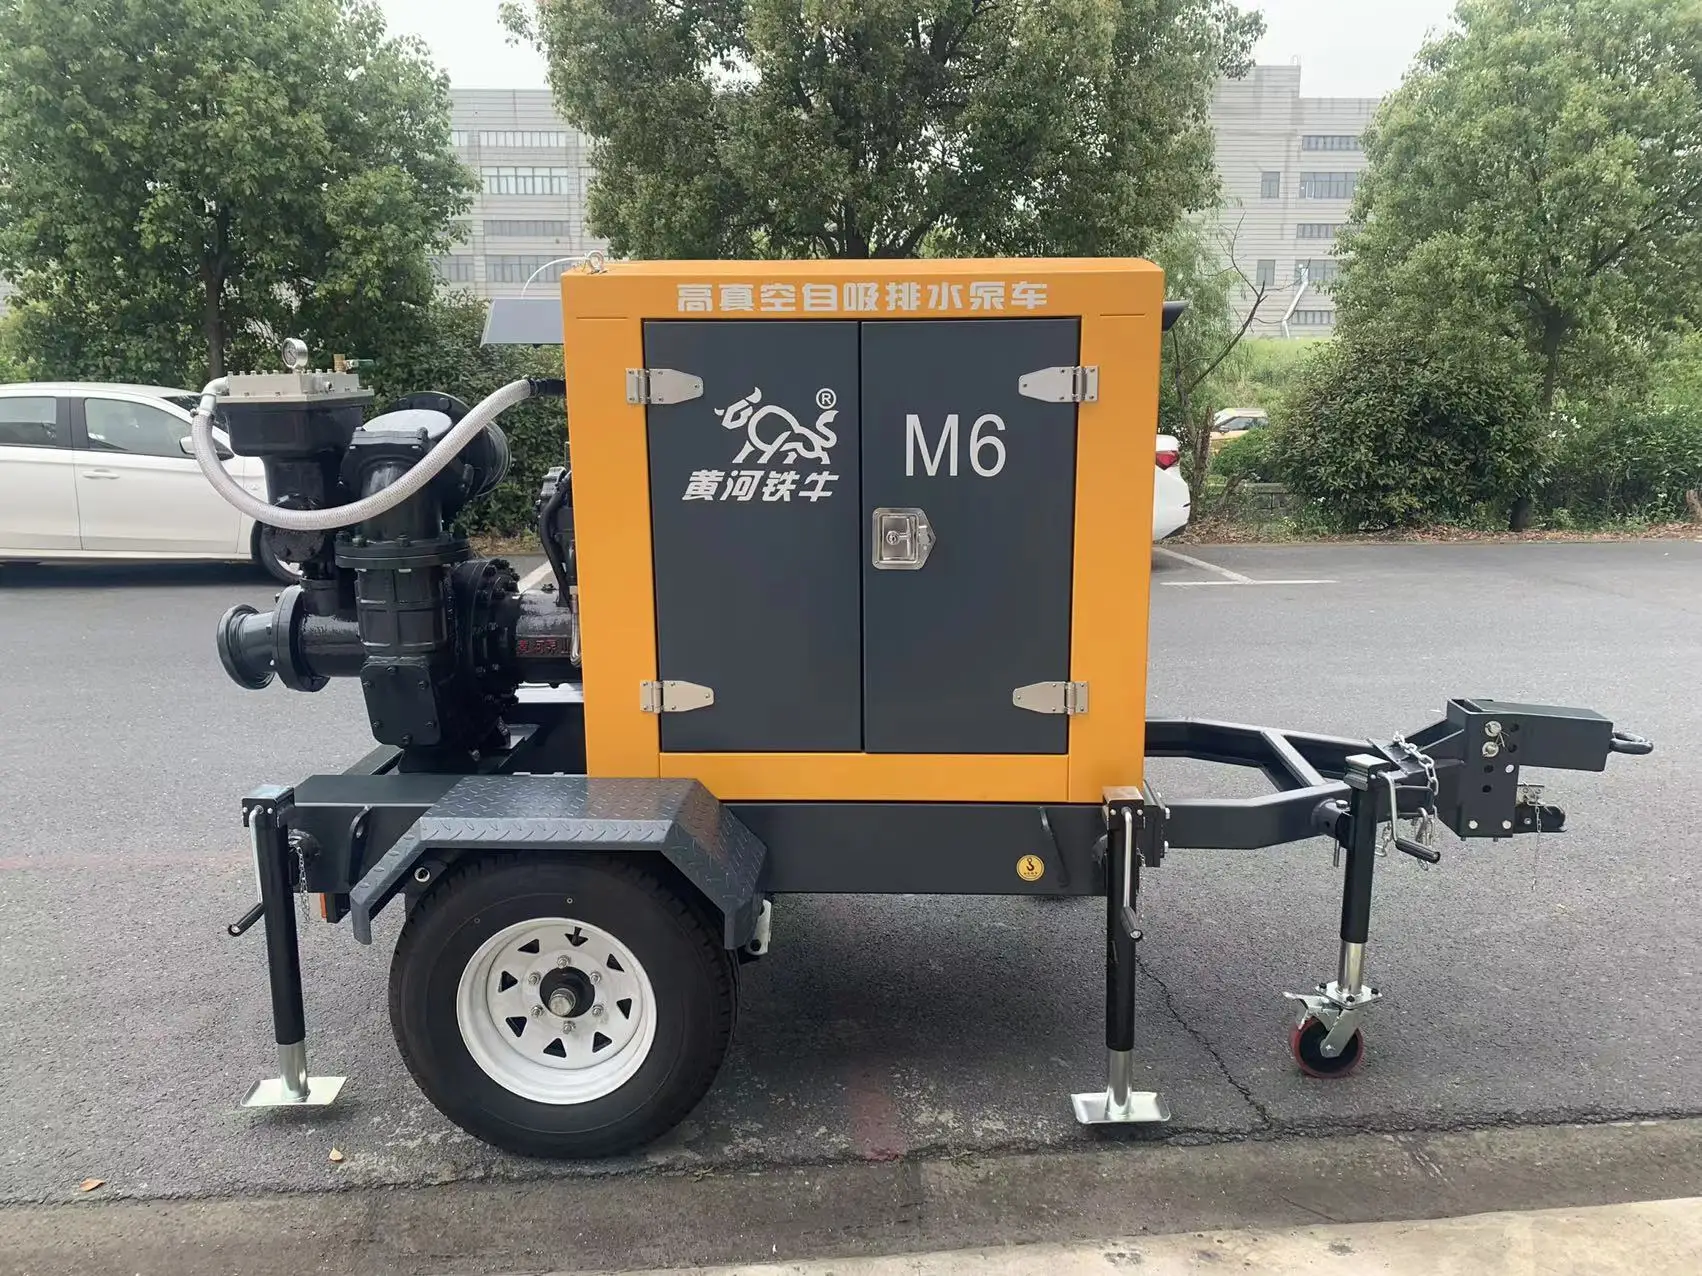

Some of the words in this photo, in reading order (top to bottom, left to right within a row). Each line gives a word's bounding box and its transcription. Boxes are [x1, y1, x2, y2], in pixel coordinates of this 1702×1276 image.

[677, 281, 1048, 312] 高真空自吸排水泵车
[905, 413, 1006, 478] M6
[682, 469, 840, 503] 黄河铁牛
